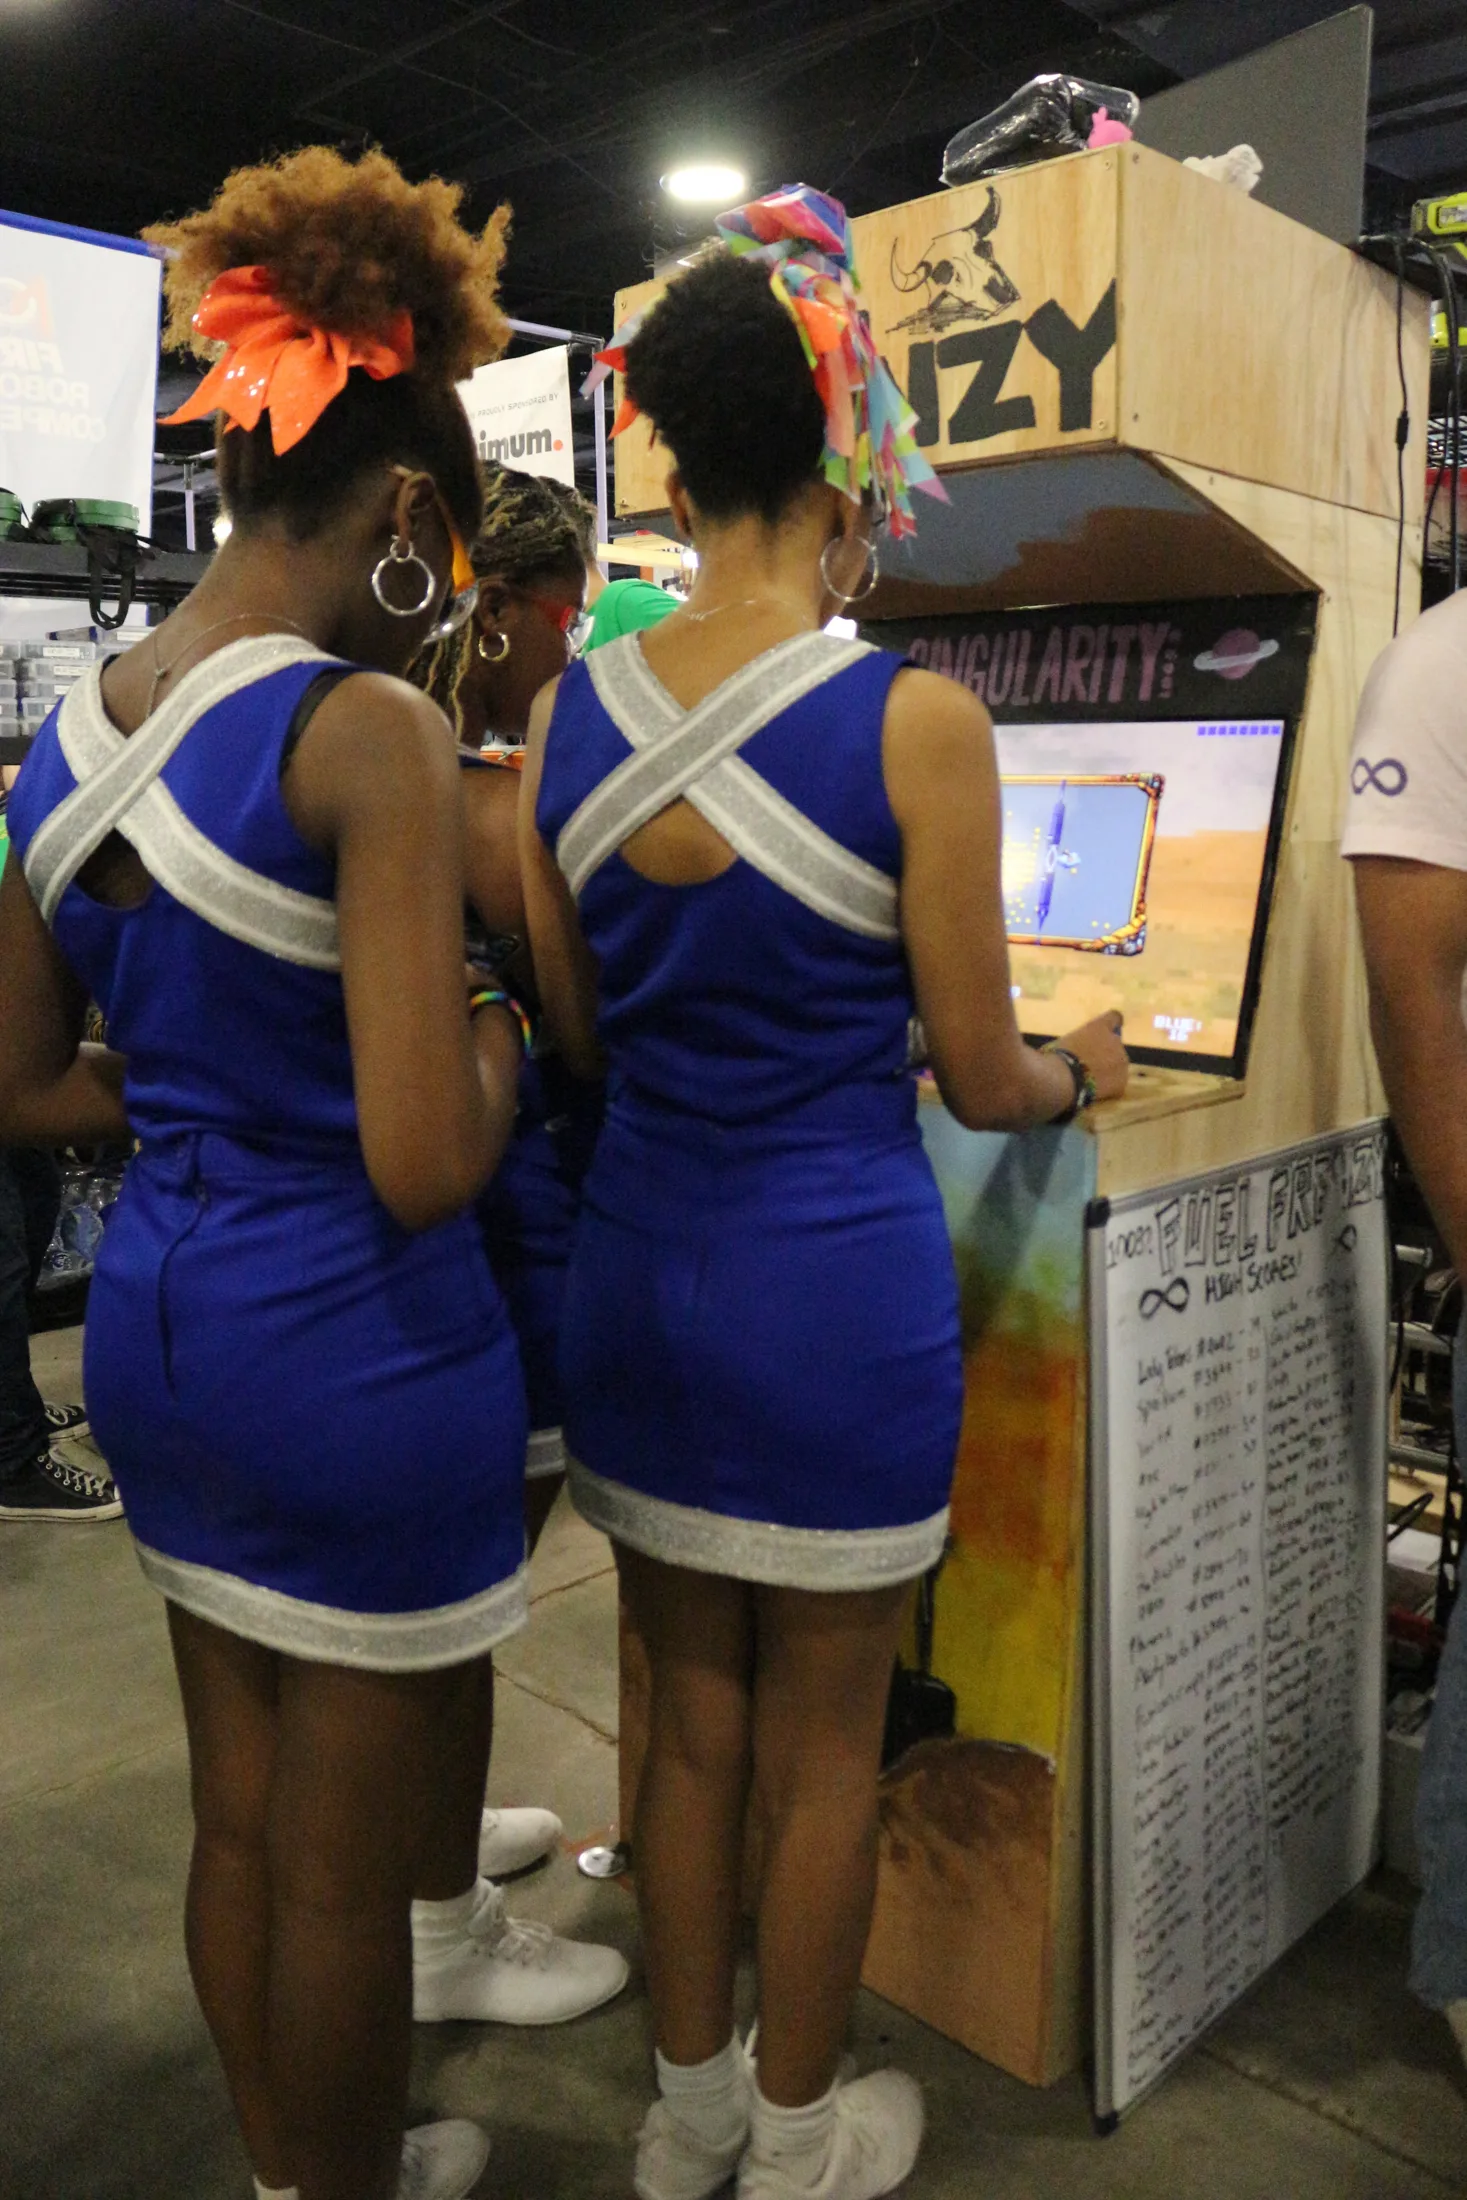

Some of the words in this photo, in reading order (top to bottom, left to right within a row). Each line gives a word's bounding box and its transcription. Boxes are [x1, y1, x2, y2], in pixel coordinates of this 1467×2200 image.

[508, 395, 547, 411] SPONSORED
[548, 392, 559, 401] BY
[1155, 1177, 1258, 1276] FUEL
